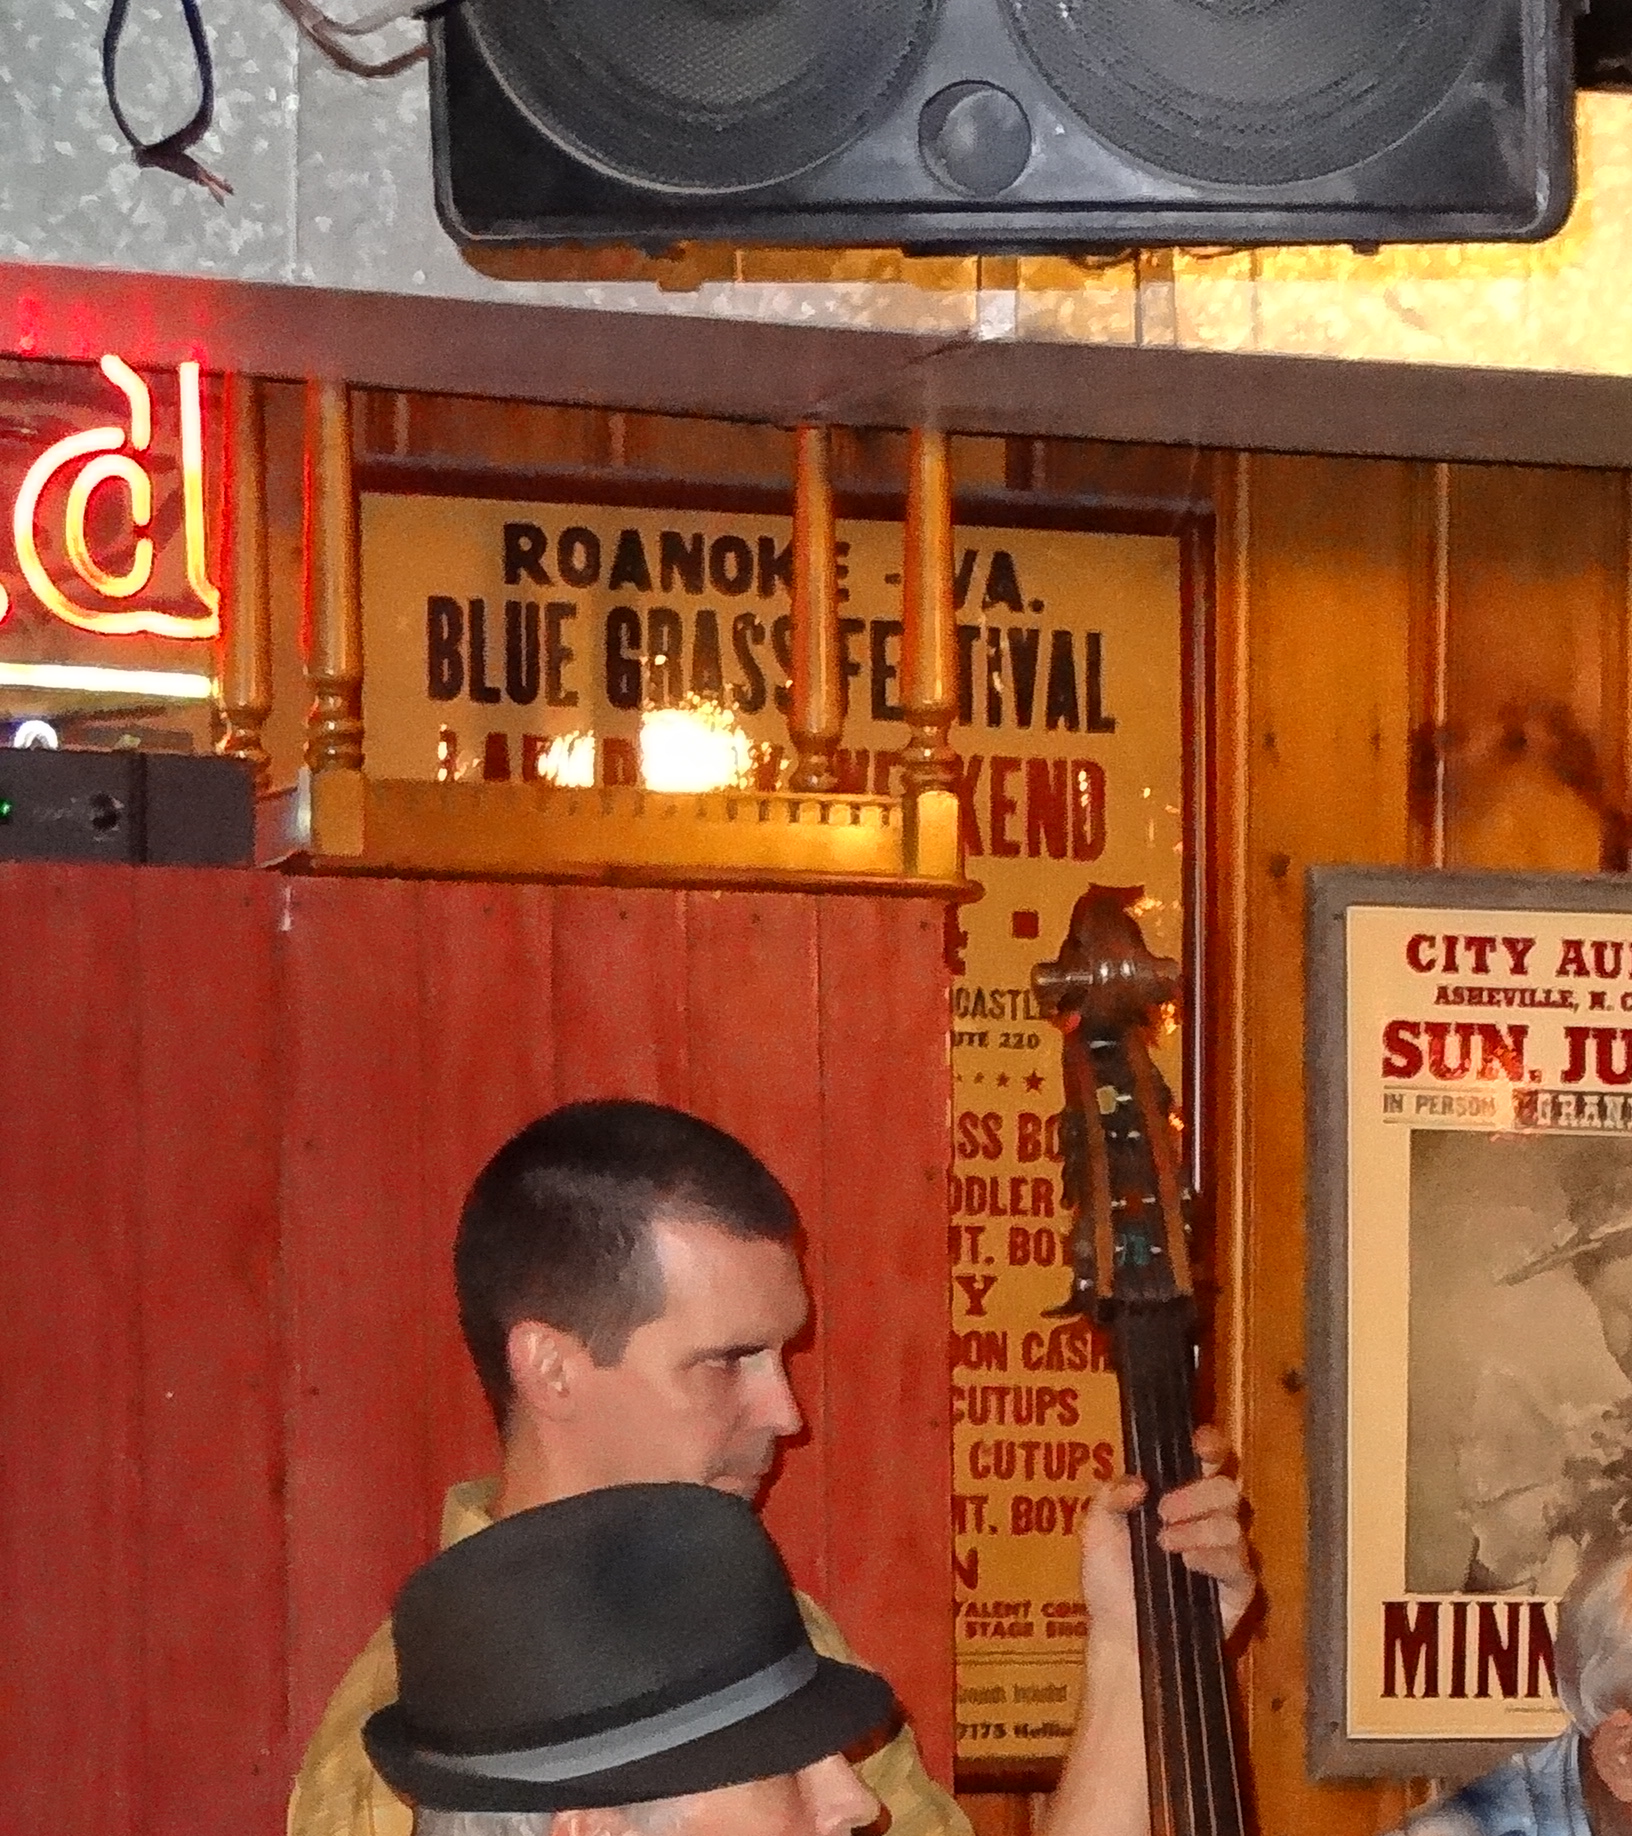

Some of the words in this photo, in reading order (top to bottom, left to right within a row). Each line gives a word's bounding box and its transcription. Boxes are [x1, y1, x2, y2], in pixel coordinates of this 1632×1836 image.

[426, 595, 579, 708] BLUE
[832, 617, 1117, 734] FETIVAL
[1406, 933, 1535, 975] CITY
[999, 1032, 1040, 1050] 220
[1381, 1020, 1542, 1084] SUN.
[969, 1440, 1115, 1482] CUTUPS
